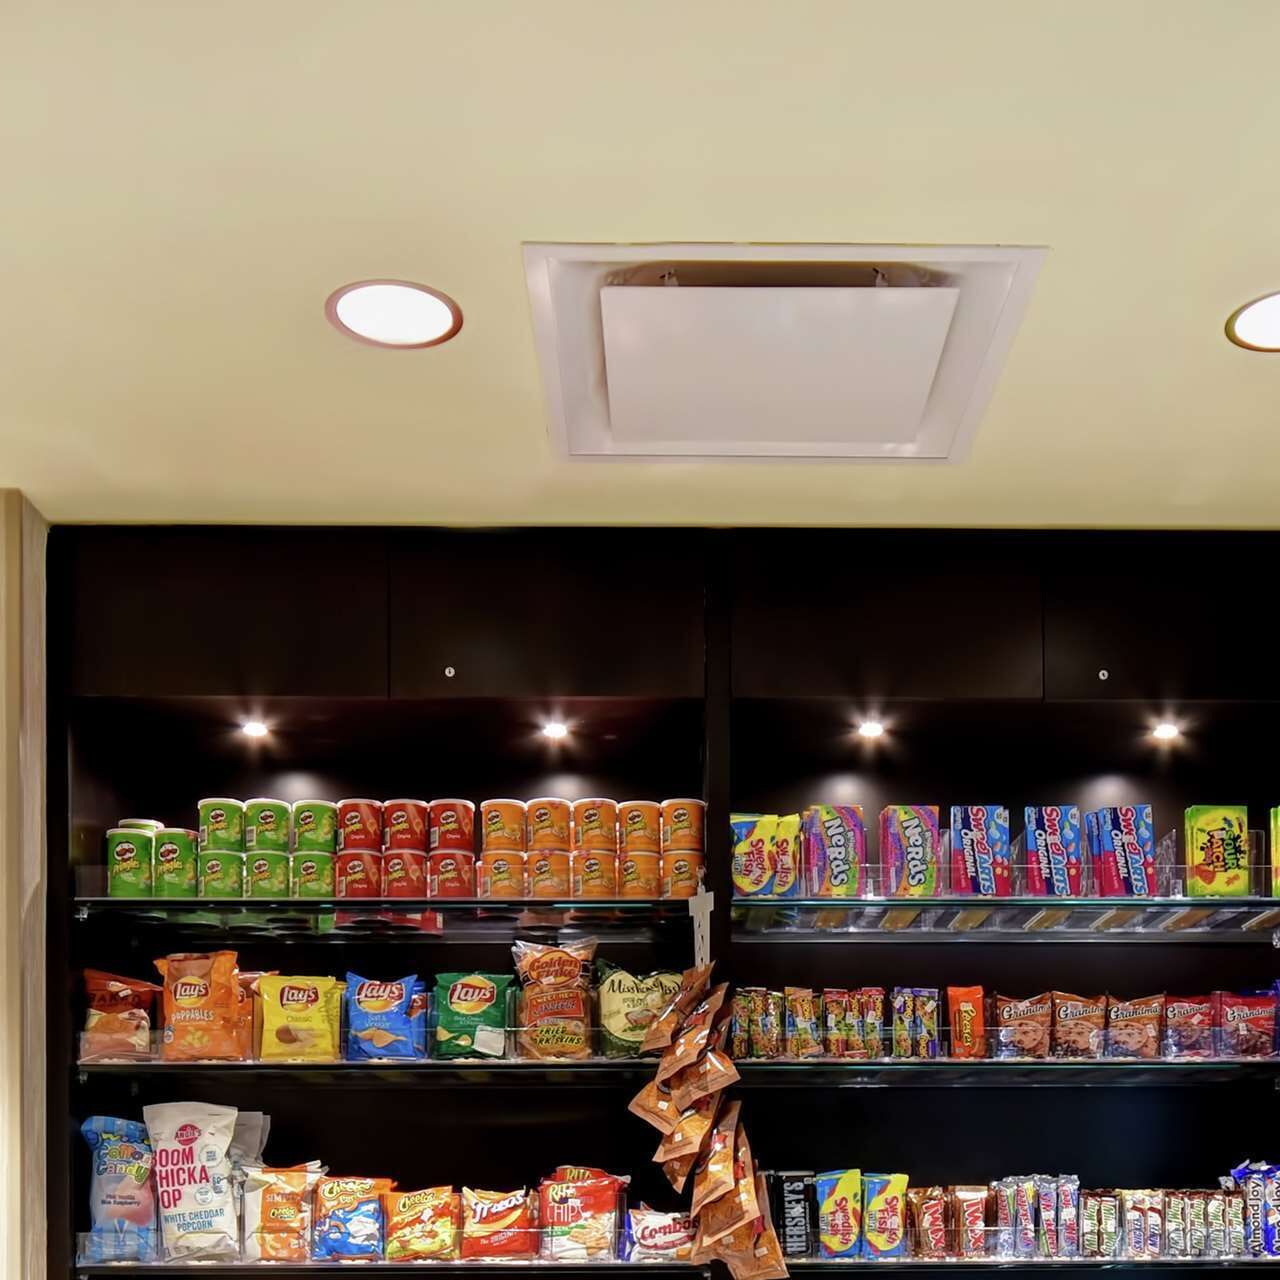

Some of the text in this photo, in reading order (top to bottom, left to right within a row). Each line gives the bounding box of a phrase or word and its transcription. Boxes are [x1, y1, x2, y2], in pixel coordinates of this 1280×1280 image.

[960, 830, 976, 877] ORIGINAL
[1033, 829, 1051, 878] ORIGINAL
[1111, 829, 1129, 878] ORIGINAL
[1208, 829, 1226, 872] PATCH
[1223, 830, 1240, 870] SOUR
[97, 1158, 150, 1184] Candy
[322, 1178, 375, 1198] Cheetos
[188, 1208, 225, 1221] CHEDDAR
[398, 1192, 436, 1212] Cheetos
[547, 1203, 585, 1224] CHIPS
[786, 1181, 805, 1254] HERSHEY'S
[1250, 1180, 1264, 1255] Almond Joy
[177, 1220, 213, 1232] POPCORN
